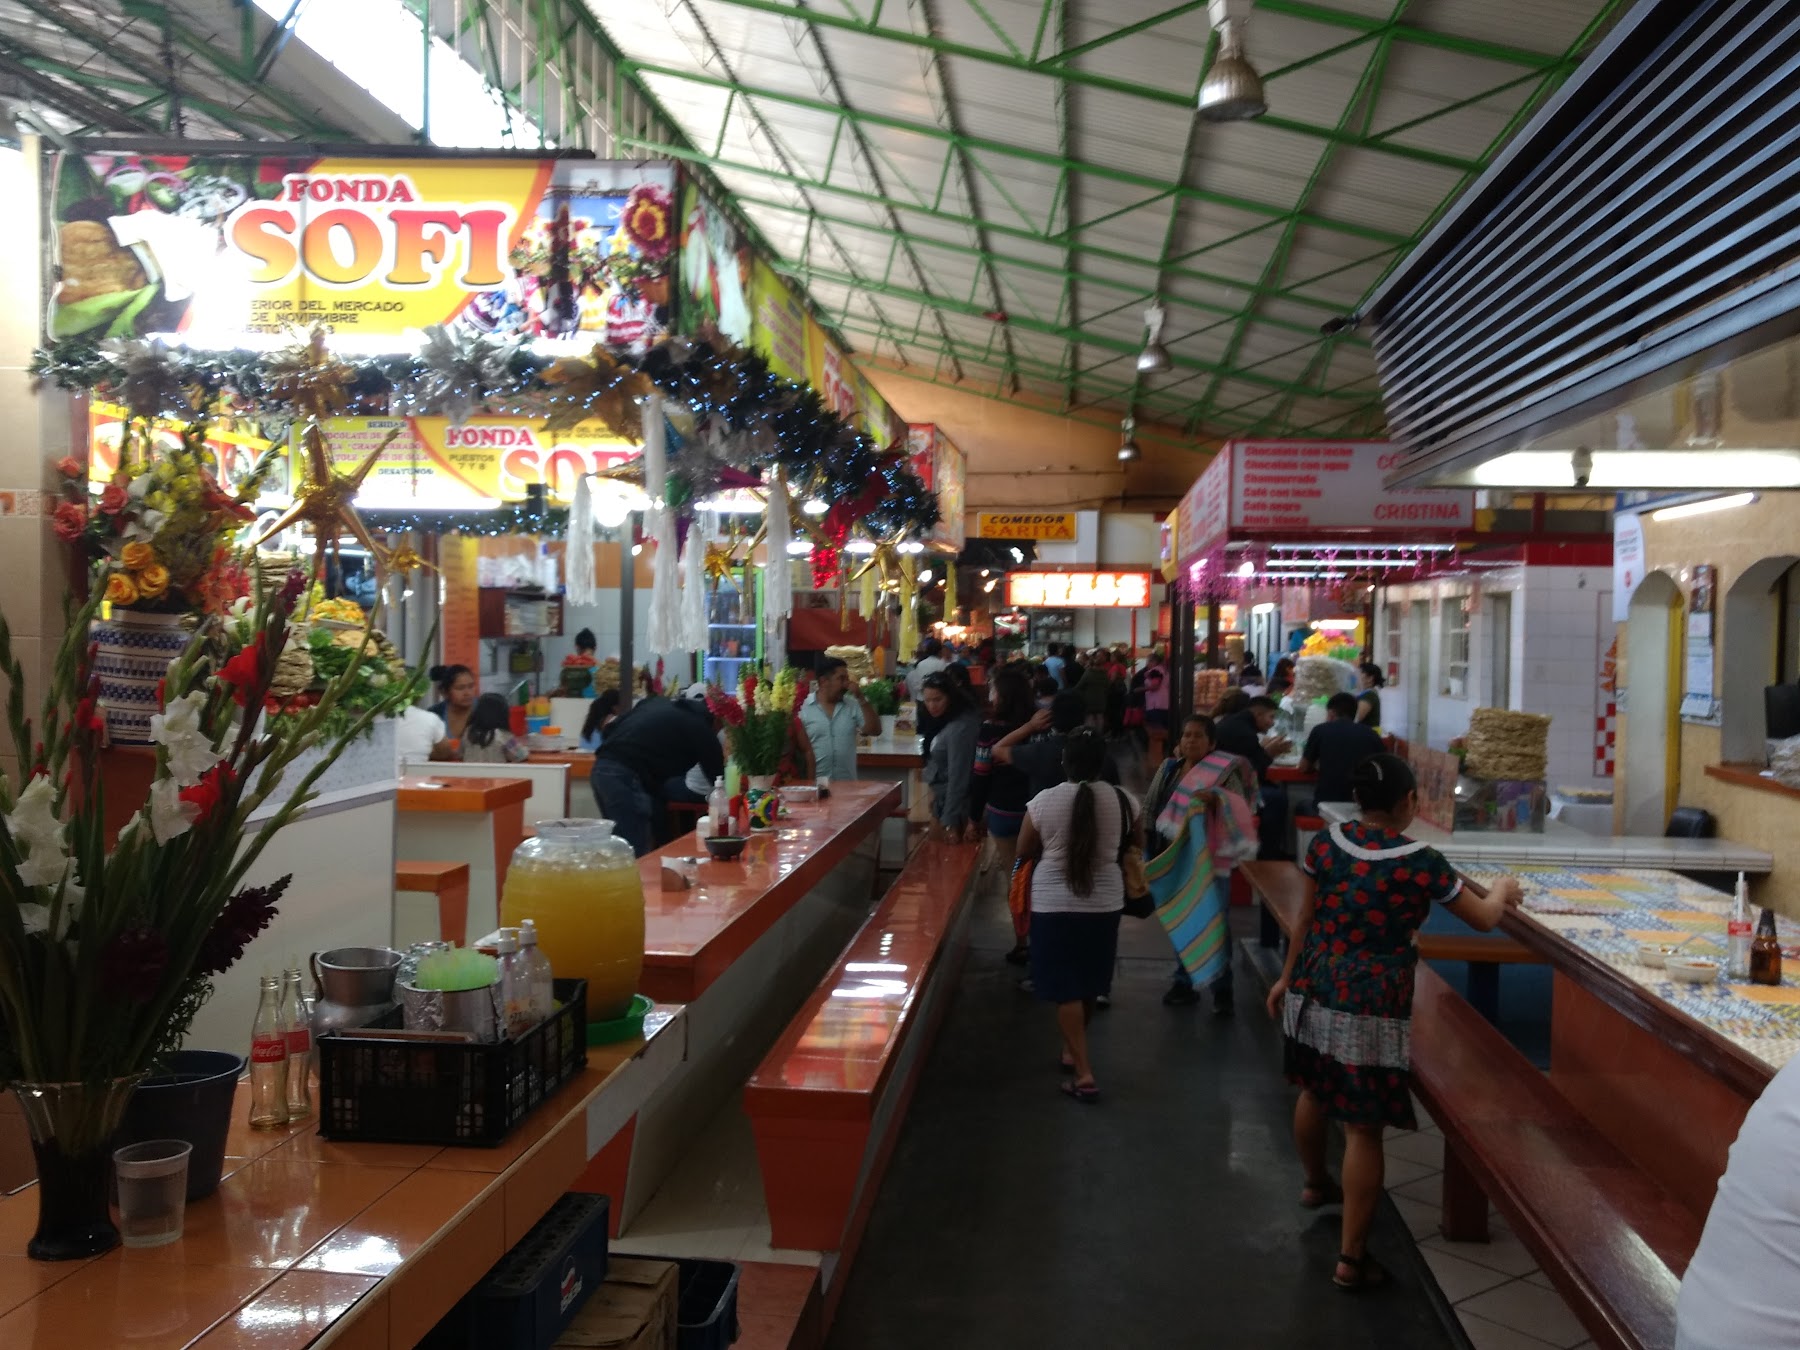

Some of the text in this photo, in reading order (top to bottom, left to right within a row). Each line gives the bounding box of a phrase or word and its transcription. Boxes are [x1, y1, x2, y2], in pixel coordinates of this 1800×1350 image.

[288, 178, 414, 203] FONDA
[231, 208, 507, 285] SOFI
[300, 301, 327, 311] DEL
[333, 301, 405, 312] MERCADO
[446, 428, 534, 447] FONDA
[449, 453, 495, 463] PUESTOS
[1373, 502, 1461, 521] CRISTINA
[989, 515, 1065, 525] COMEDOR
[982, 525, 1070, 537] SARITA
